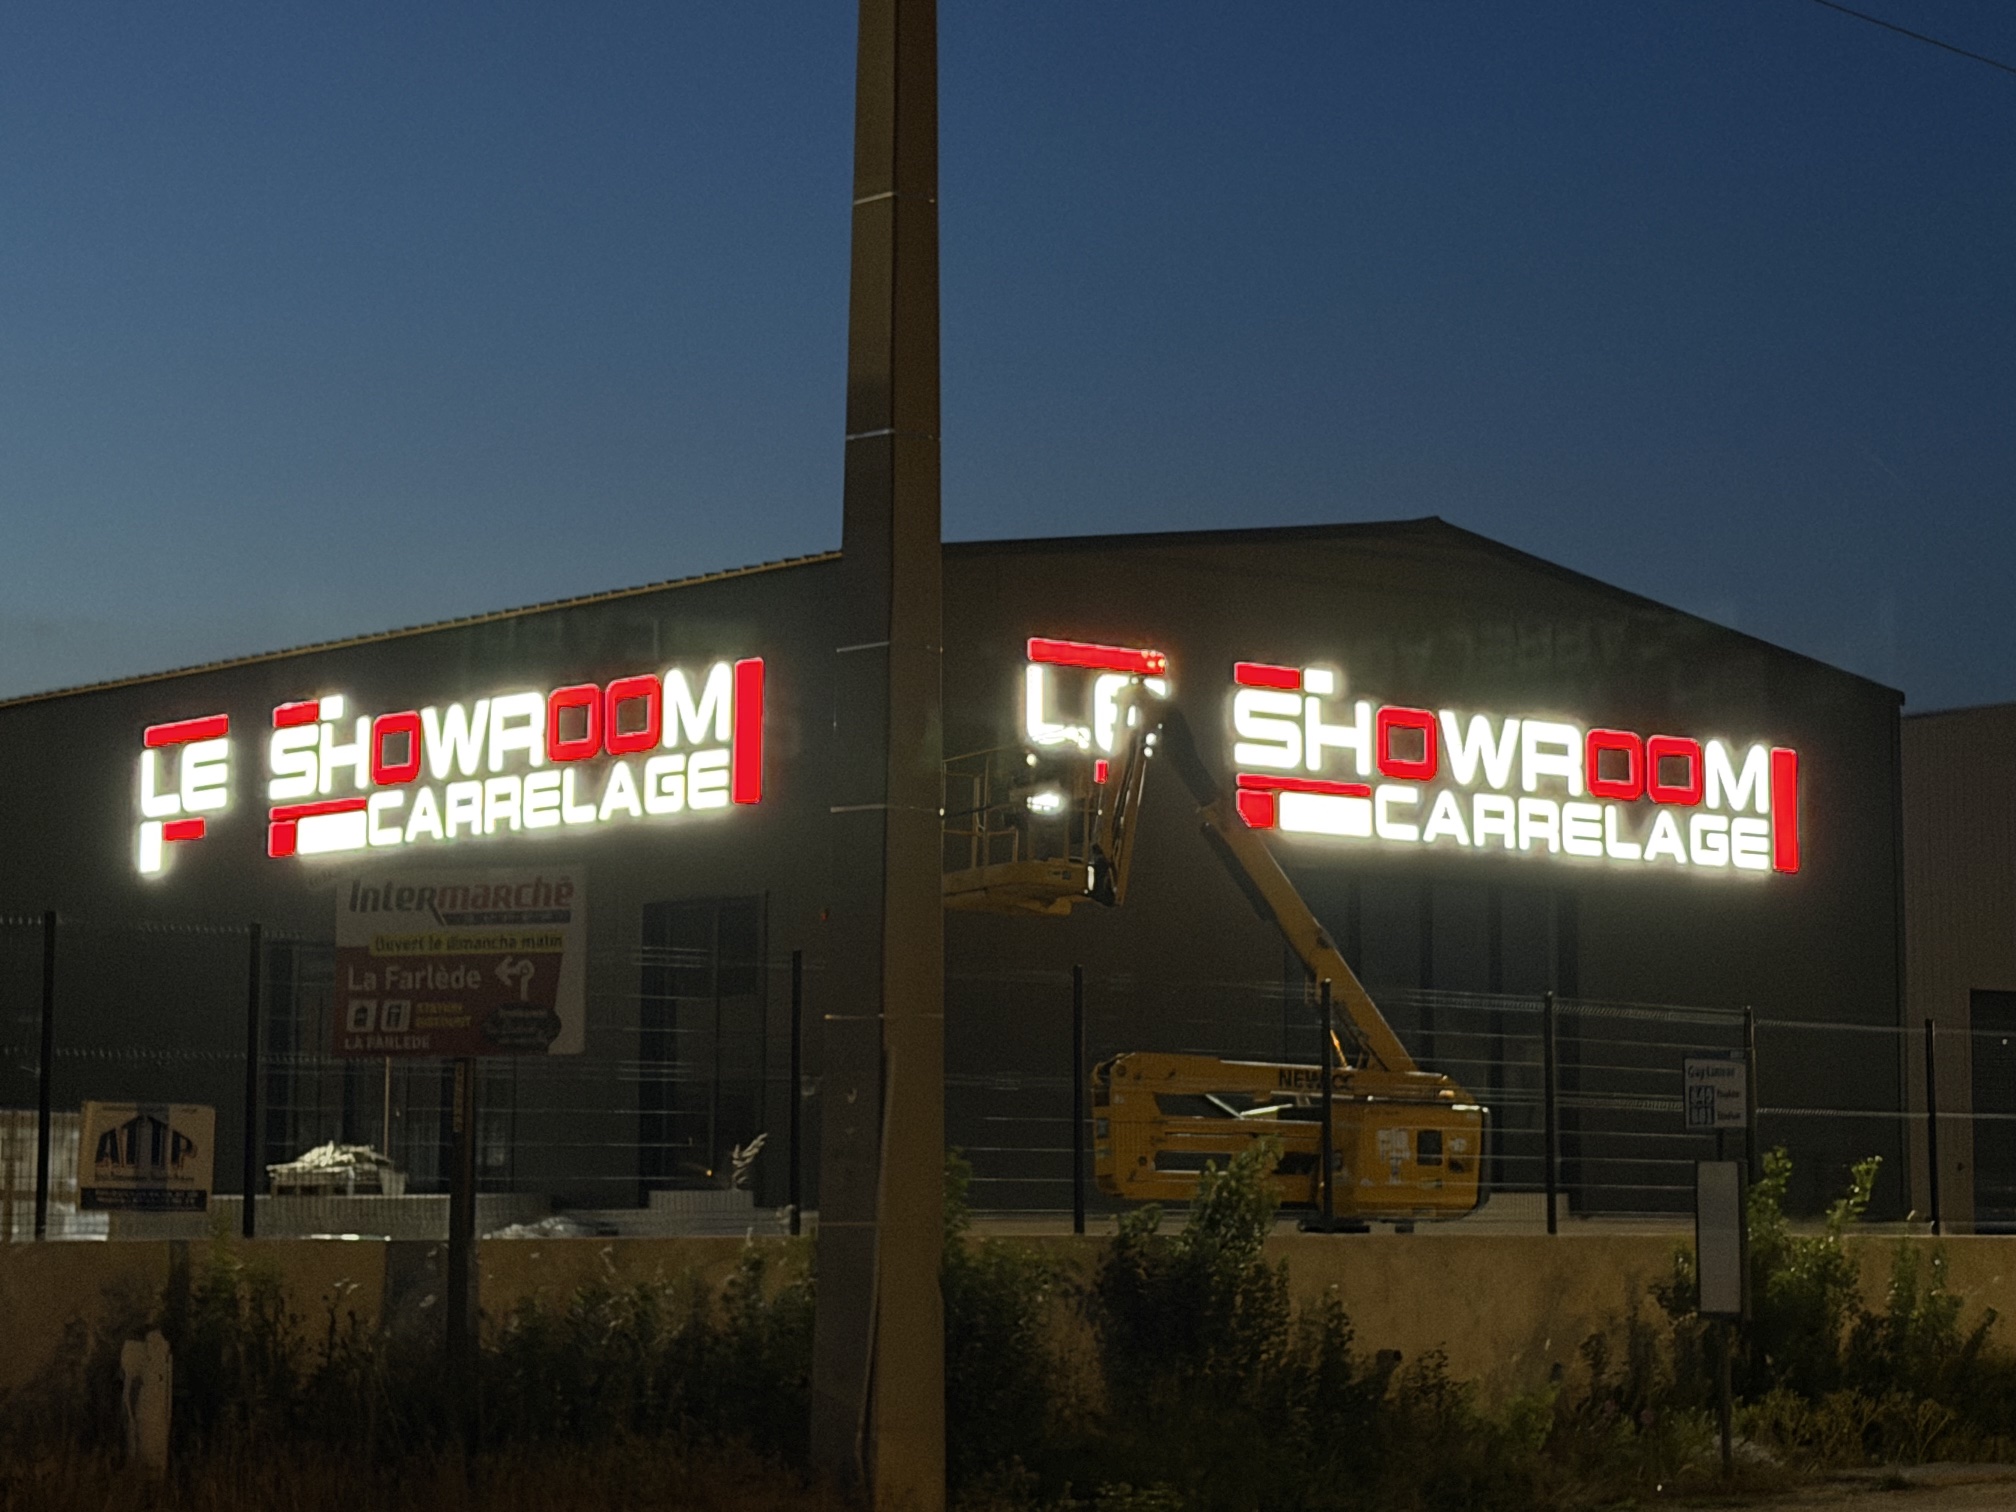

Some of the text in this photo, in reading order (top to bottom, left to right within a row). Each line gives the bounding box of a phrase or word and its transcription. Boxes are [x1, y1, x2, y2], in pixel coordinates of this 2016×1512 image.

[140, 664, 732, 818] LE SHOWROOM
[1234, 689, 1770, 814] SHOWROOM
[366, 748, 730, 846] CARRELAGE
[1374, 787, 1770, 870] CARRELAGE
[347, 963, 482, 991] La Farlède
